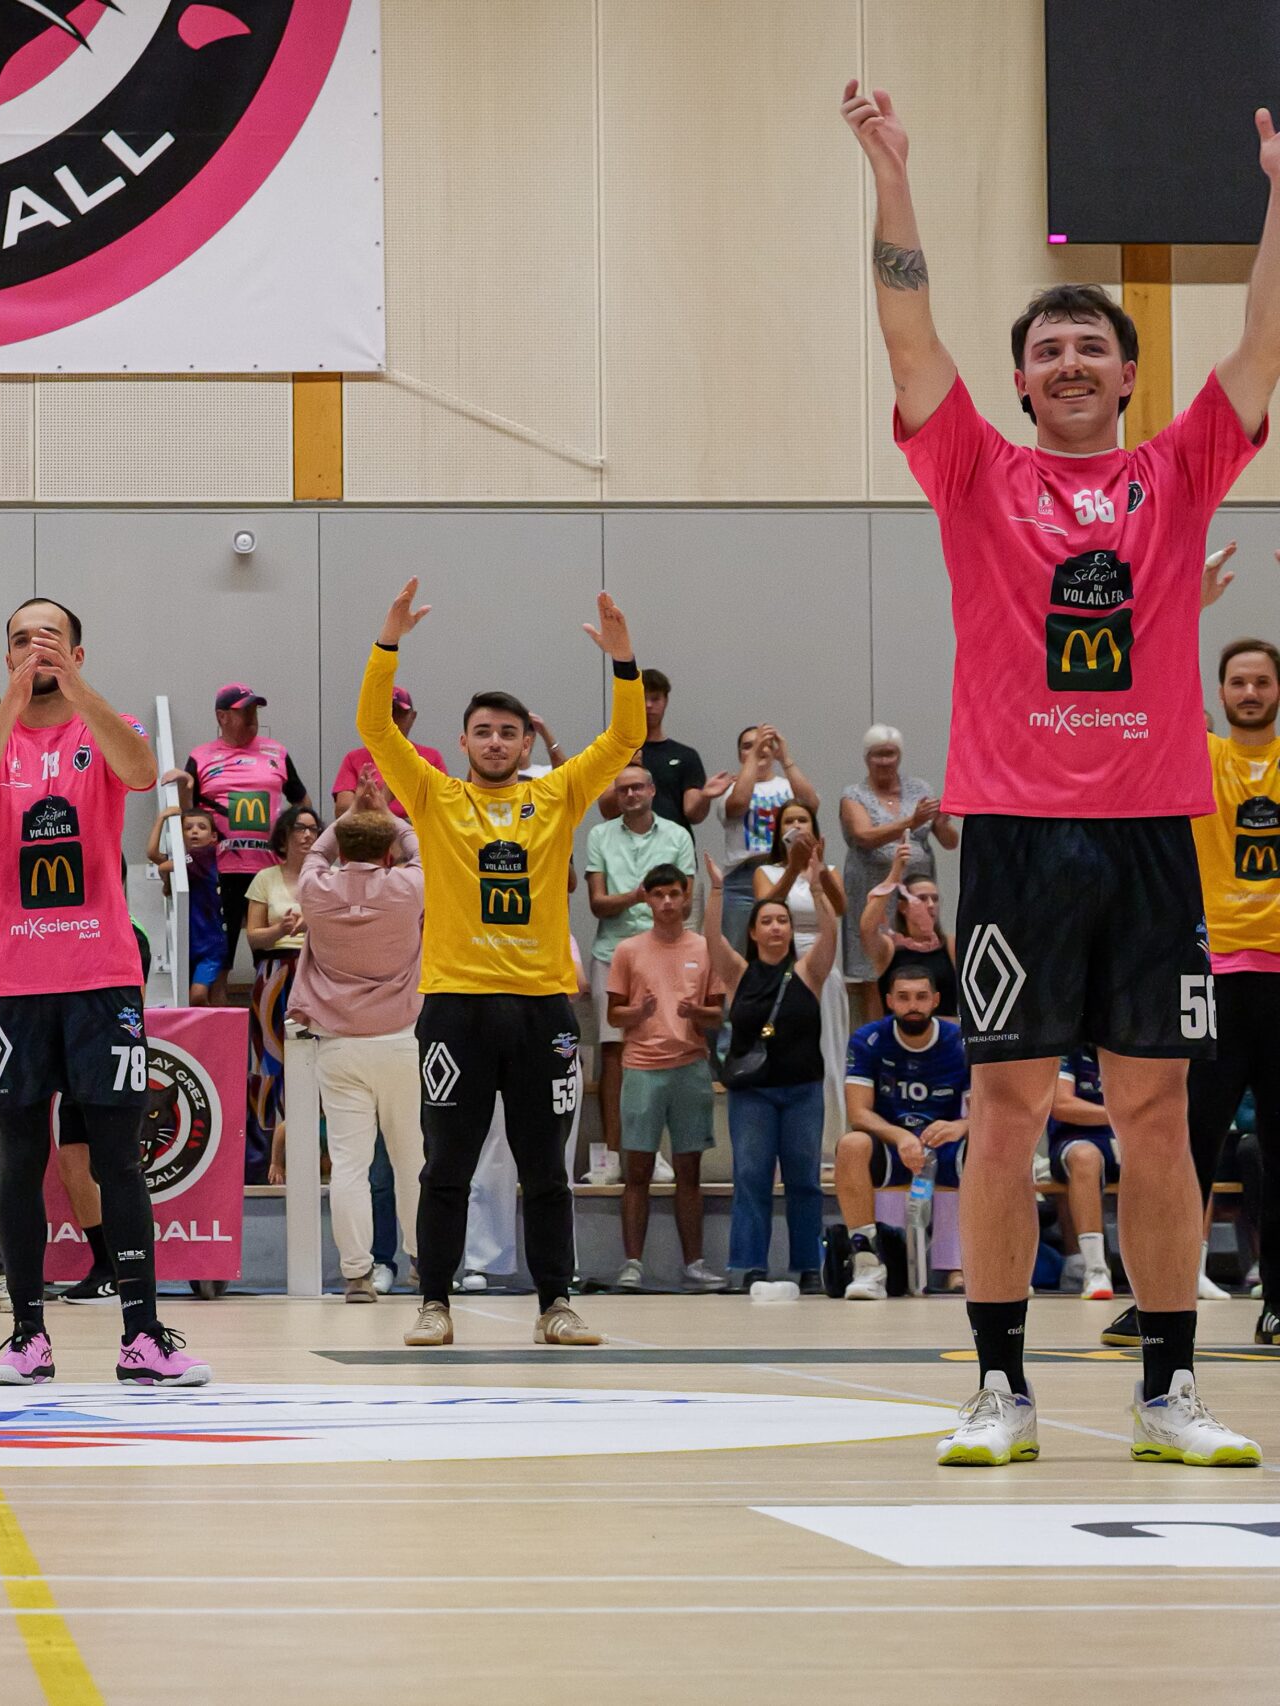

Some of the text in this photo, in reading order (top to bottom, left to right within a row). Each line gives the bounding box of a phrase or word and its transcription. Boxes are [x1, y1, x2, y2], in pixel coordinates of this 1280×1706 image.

[110, 1045, 147, 1092] 78
[175, 1069, 207, 1111] GREZ
[551, 1076, 578, 1116] 53
[896, 1080, 929, 1102] 10
